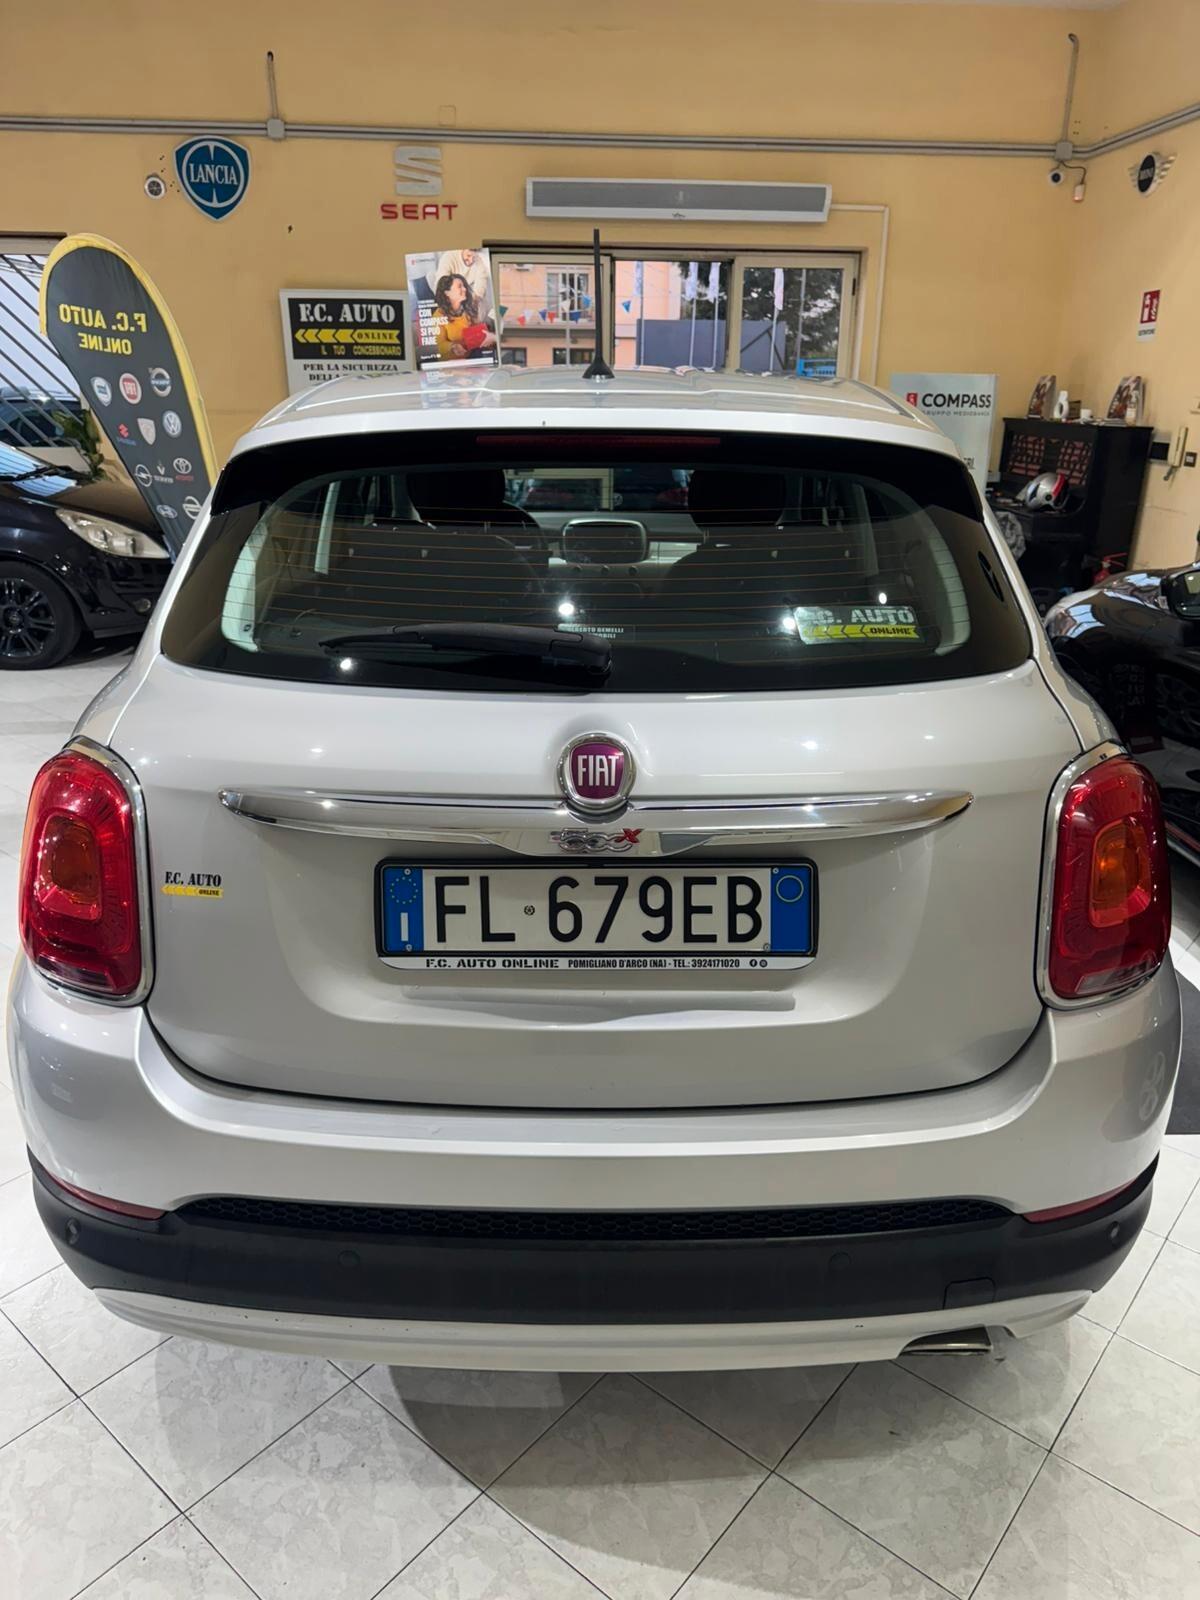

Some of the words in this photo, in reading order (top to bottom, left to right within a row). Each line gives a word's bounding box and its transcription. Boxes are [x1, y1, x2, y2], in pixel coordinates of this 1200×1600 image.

[189, 163, 238, 185] LANCIA
[381, 203, 458, 220] SEAT
[299, 303, 333, 322] F.C.
[340, 303, 396, 323] AUTO
[420, 317, 448, 327] COMPASS
[357, 332, 393, 340] ONLINE
[303, 363, 324, 371] PER
[327, 363, 340, 371] LA
[922, 393, 992, 408] COMPASS
[851, 608, 914, 624] AUTO
[869, 627, 911, 635] ONLINE
[577, 754, 620, 787] FIAT
[165, 871, 184, 885] F.C.
[188, 873, 222, 887] AUTO
[435, 876, 516, 943] FL
[548, 876, 762, 943] 679EB
[426, 959, 451, 968] F.C.
[457, 959, 497, 968] AUTO
[502, 959, 559, 968] ONLINE
[568, 959, 617, 968] POMIGLIANO
[619, 959, 647, 968] D'ARCO
[649, 959, 666, 968] (NA)
[692, 959, 740, 968] 3924171020
